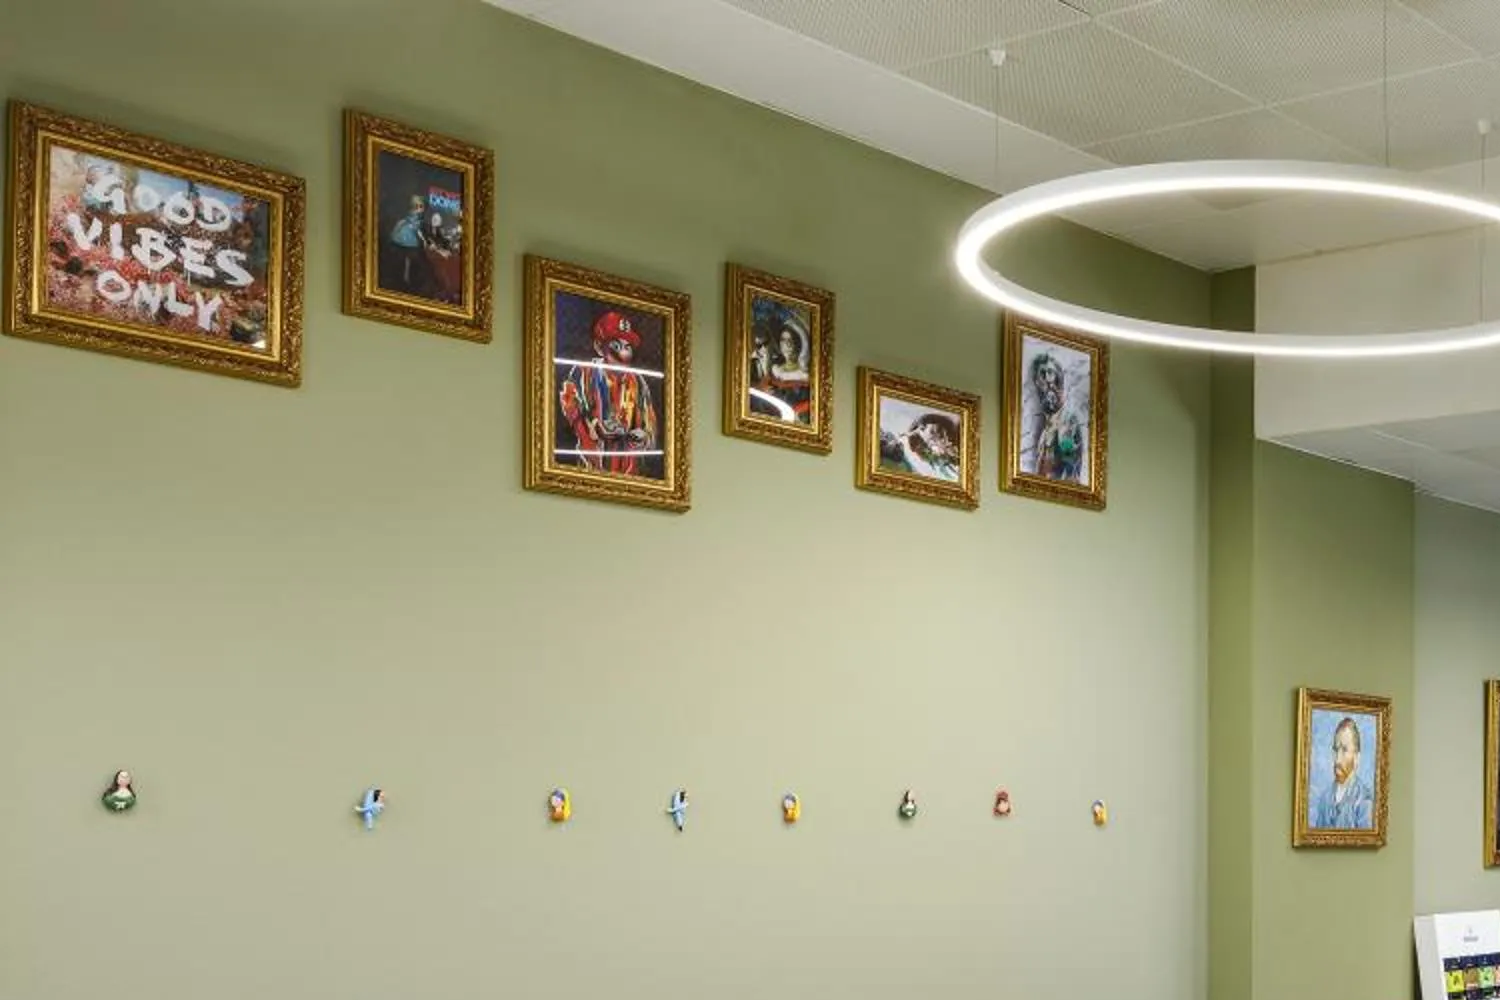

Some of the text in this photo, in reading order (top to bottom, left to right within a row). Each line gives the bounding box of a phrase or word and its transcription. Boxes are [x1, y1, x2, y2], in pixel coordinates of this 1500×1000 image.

[83, 165, 232, 231] GOOD
[67, 212, 255, 288] VIBES
[96, 270, 223, 332] ONLY
